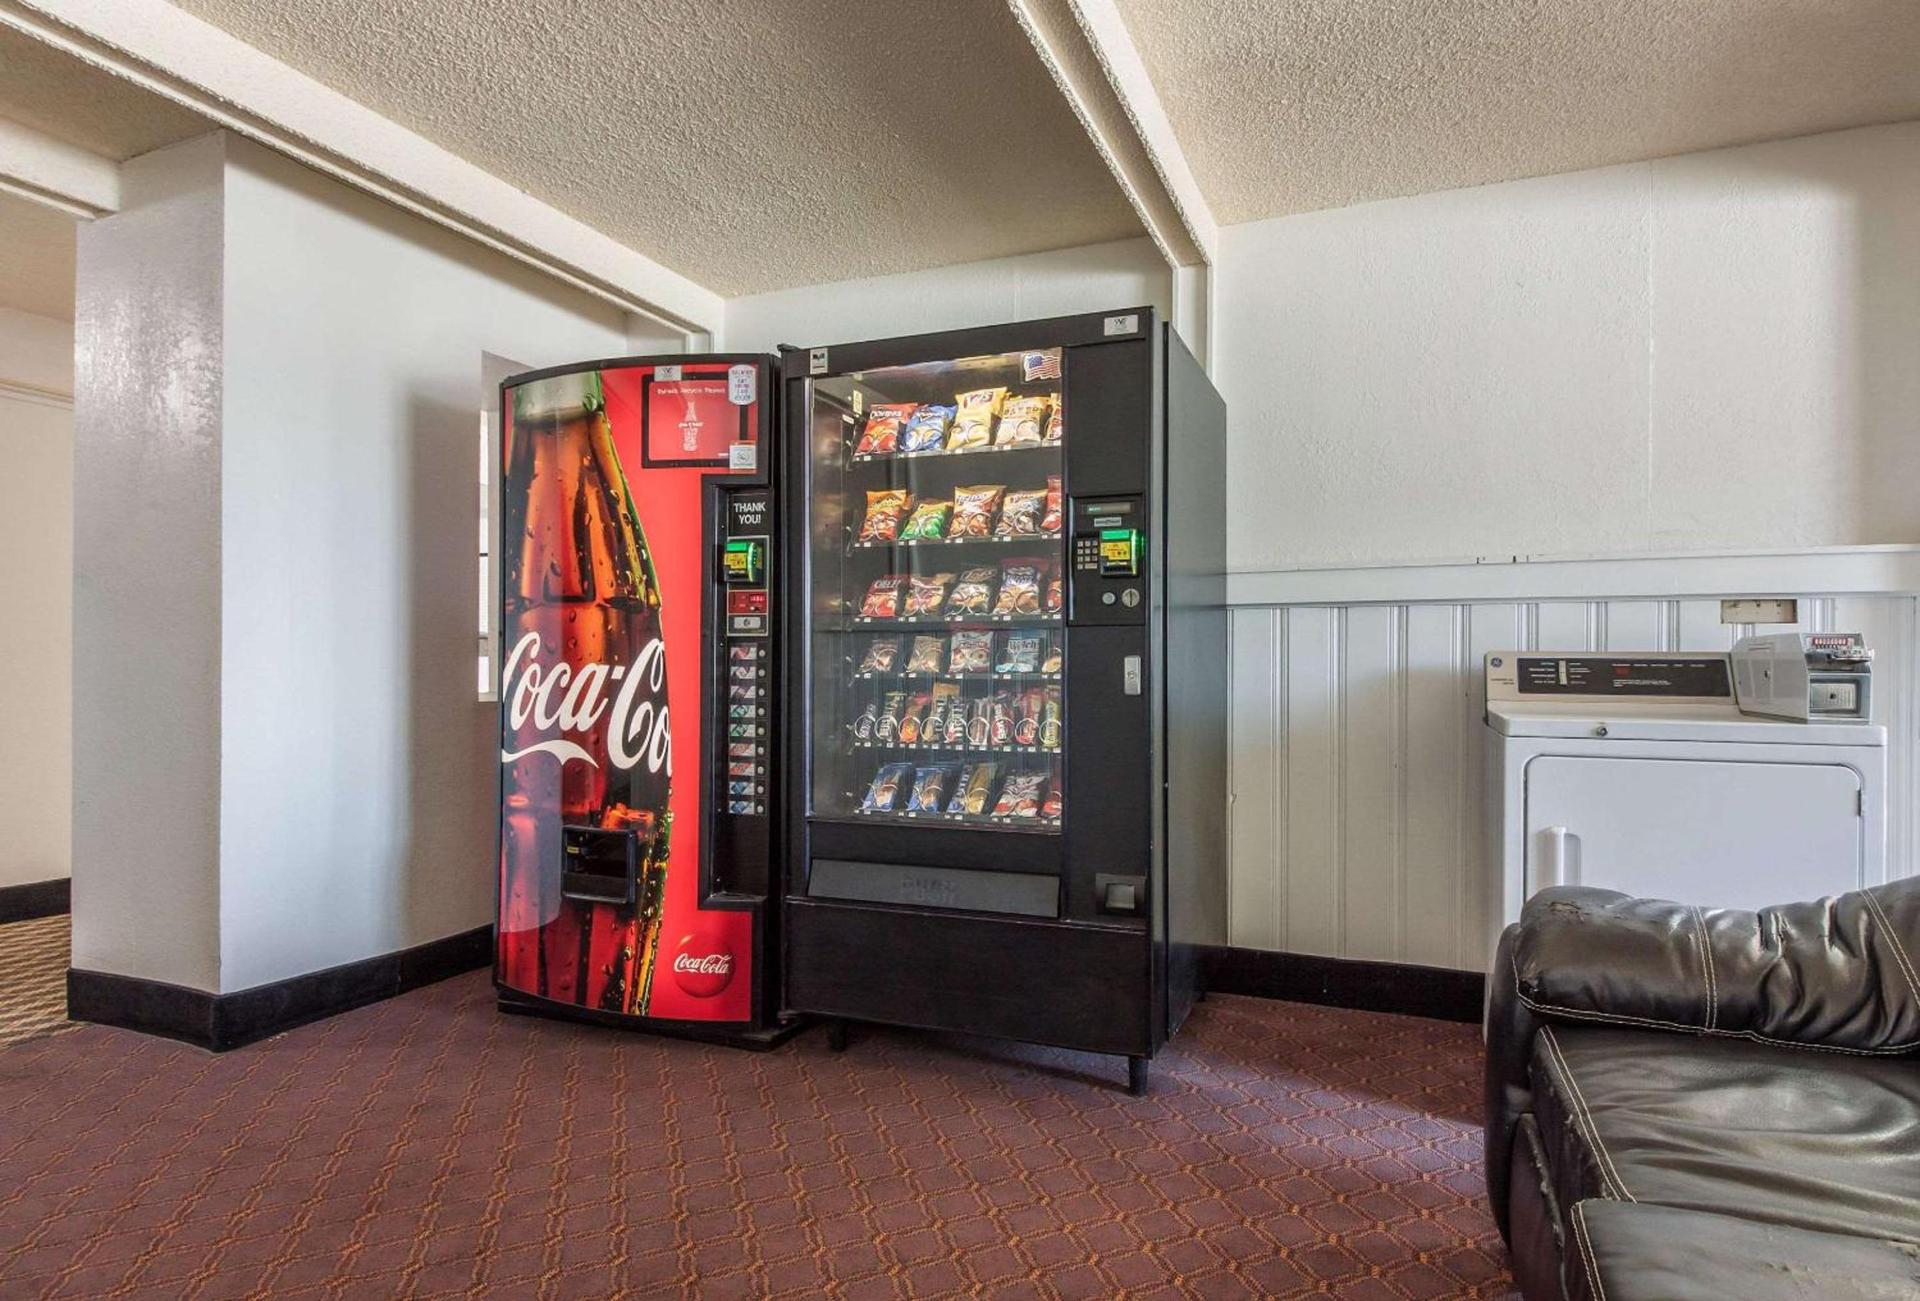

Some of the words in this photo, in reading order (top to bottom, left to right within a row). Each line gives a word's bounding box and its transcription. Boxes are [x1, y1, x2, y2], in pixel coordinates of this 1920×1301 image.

[733, 502, 766, 513] THANK
[738, 514, 761, 524] YOU!
[502, 631, 672, 777] Coca-Co
[674, 953, 732, 974] Coca-Cola
